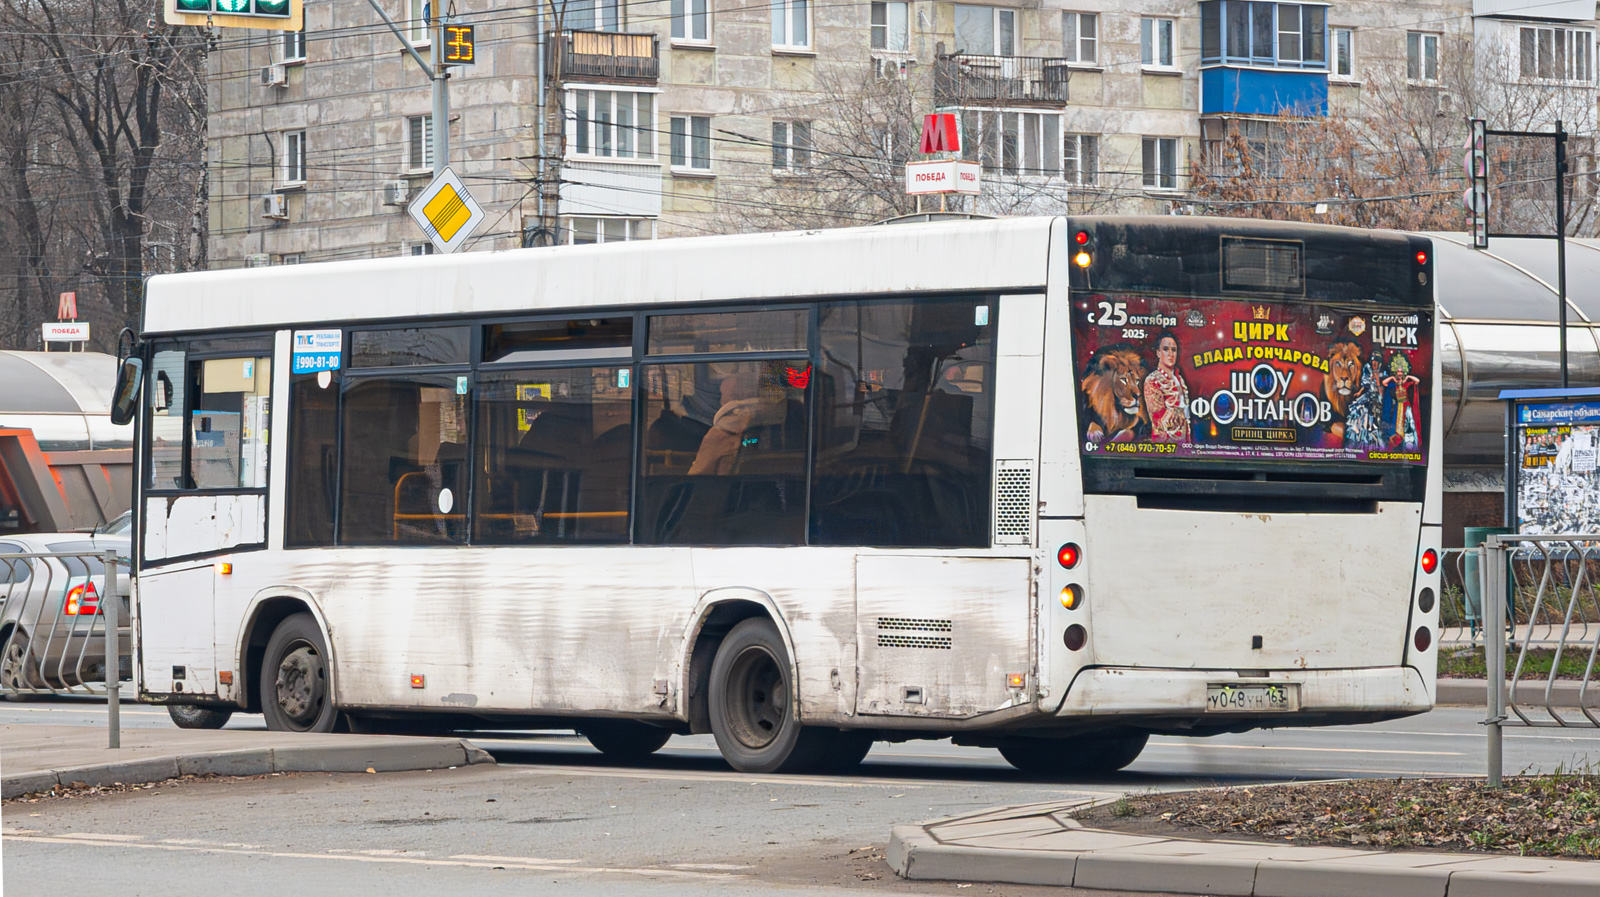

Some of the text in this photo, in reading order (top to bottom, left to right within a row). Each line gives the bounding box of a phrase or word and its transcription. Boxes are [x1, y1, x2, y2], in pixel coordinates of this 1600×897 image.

[447, 27, 473, 60] 35
[915, 172, 946, 182] ПОБЕДА
[960, 172, 976, 182] ПОБЕДА
[1087, 312, 1095, 323] с
[1097, 301, 1128, 326] 25
[1129, 314, 1177, 328] октября
[1234, 321, 1289, 342] ЦИРК
[1372, 325, 1418, 347] ЦИРК
[300, 356, 339, 368] 990-81-80
[1193, 346, 1329, 373] ВЛАДА ГОНЧАРОВА
[1231, 363, 1293, 398] ШОУ
[1190, 389, 1332, 427] ФОНТАНОВ
[1532, 409, 1573, 420] Самарские
[1234, 429, 1294, 440] ПРИНЦ ЦИРКА
[1085, 441, 1099, 452] 0+
[1105, 443, 1115, 452] +7
[1117, 443, 1137, 453] (846)
[1138, 443, 1176, 453] 970-70-57
[1369, 450, 1421, 460] circus-samara.ru
